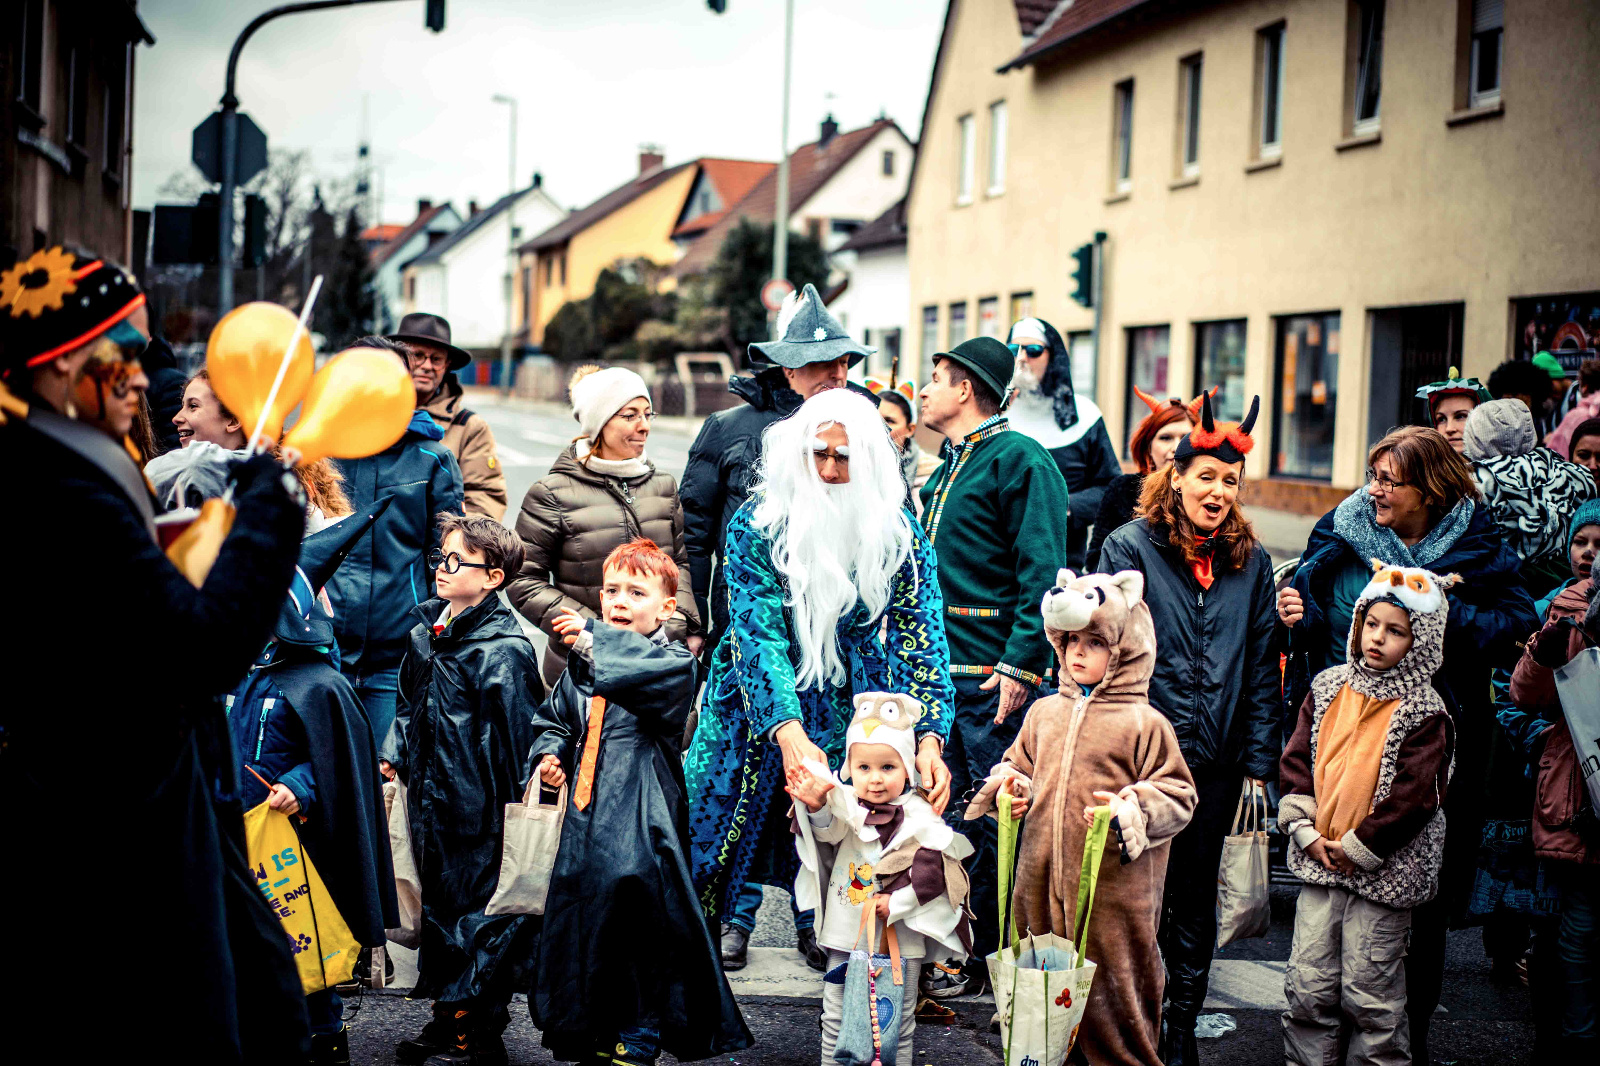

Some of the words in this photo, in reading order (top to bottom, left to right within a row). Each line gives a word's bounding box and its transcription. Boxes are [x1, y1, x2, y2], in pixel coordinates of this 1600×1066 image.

[271, 847, 299, 872] IS
[284, 883, 310, 903] AND
[1020, 1054, 1039, 1066] dm
